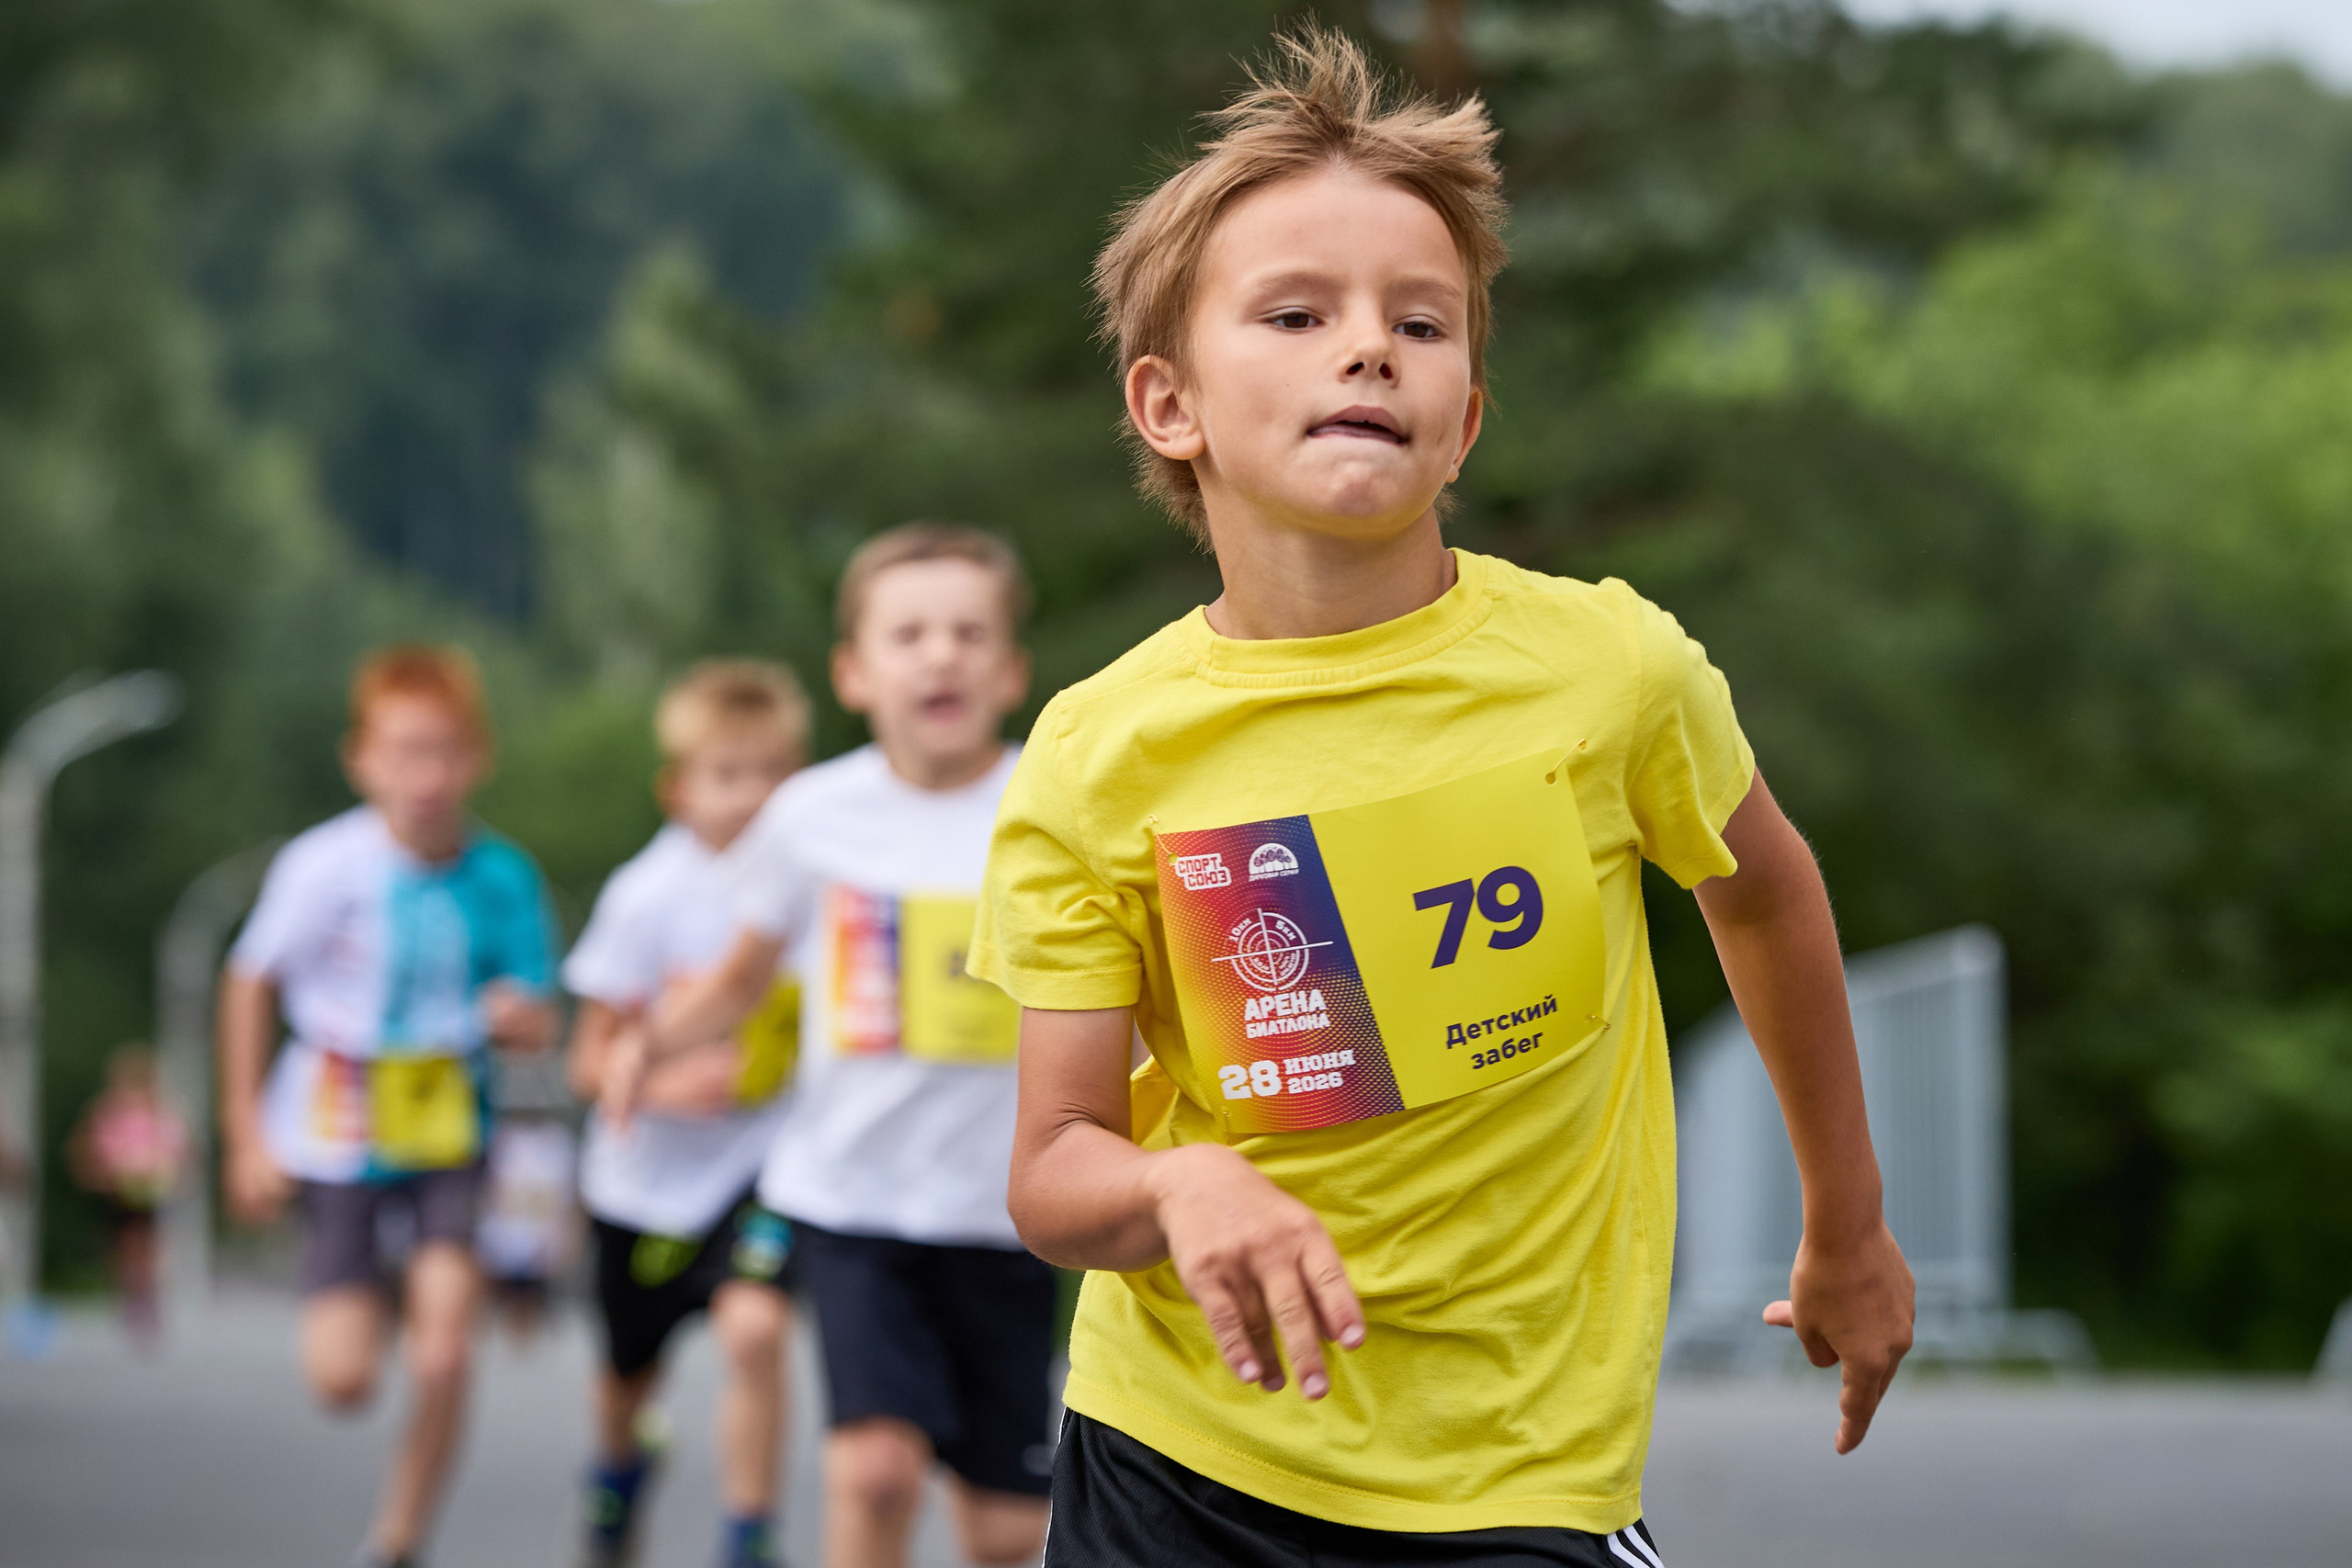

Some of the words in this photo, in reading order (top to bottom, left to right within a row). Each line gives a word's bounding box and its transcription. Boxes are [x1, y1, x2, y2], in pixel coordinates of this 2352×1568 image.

[1178, 856, 1219, 874] СПОРТ
[1187, 869, 1227, 887] СОЮЗ
[1413, 865, 1544, 969] 79
[1244, 988, 1327, 1021] АРЕНА
[1246, 1012, 1330, 1039] БИАТЛОНА
[1446, 994, 1557, 1049] Детский
[1471, 1032, 1544, 1070] забег
[1217, 1060, 1283, 1100] 28
[1283, 1049, 1356, 1075] ИЮНЯ
[1287, 1071, 1343, 1094] 2026
